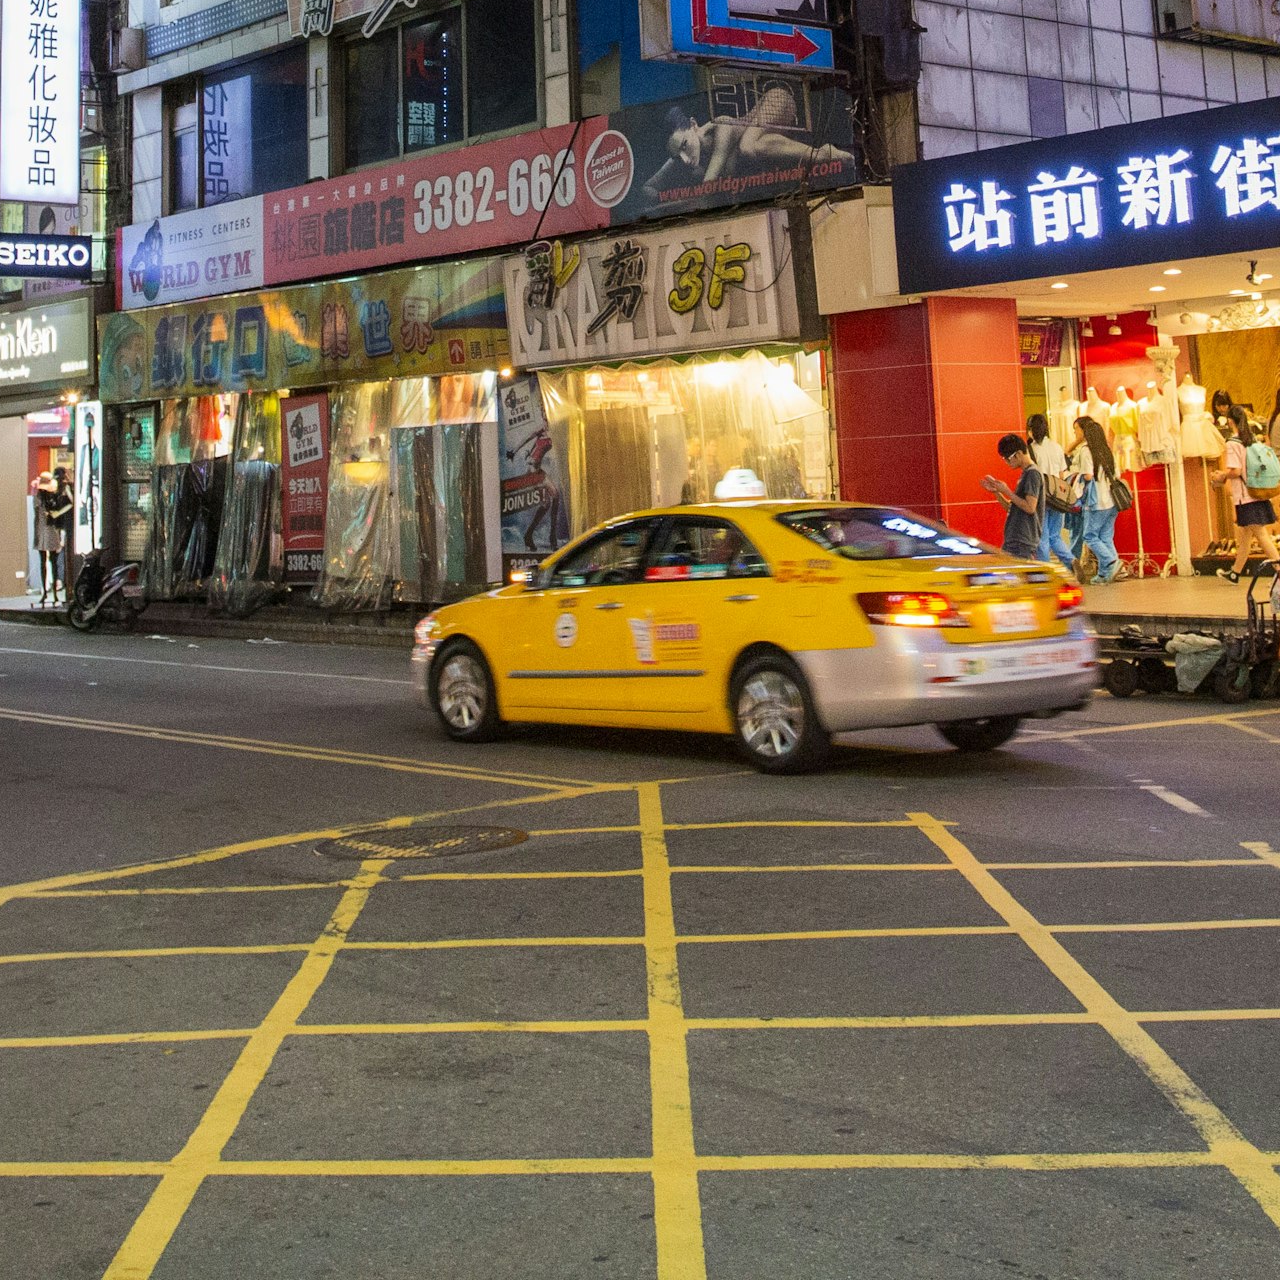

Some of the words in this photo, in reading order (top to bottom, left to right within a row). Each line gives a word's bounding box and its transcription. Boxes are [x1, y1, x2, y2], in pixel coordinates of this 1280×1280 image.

[591, 158, 625, 181] Taiwan
[413, 147, 577, 235] 3382-666
[169, 228, 204, 245] FITNESS
[212, 216, 252, 236] CENTERS
[204, 250, 253, 283] GYM
[668, 242, 752, 314] 3F
[16, 314, 58, 358] Klein
[502, 495, 525, 514] JOIN
[528, 490, 541, 506] US
